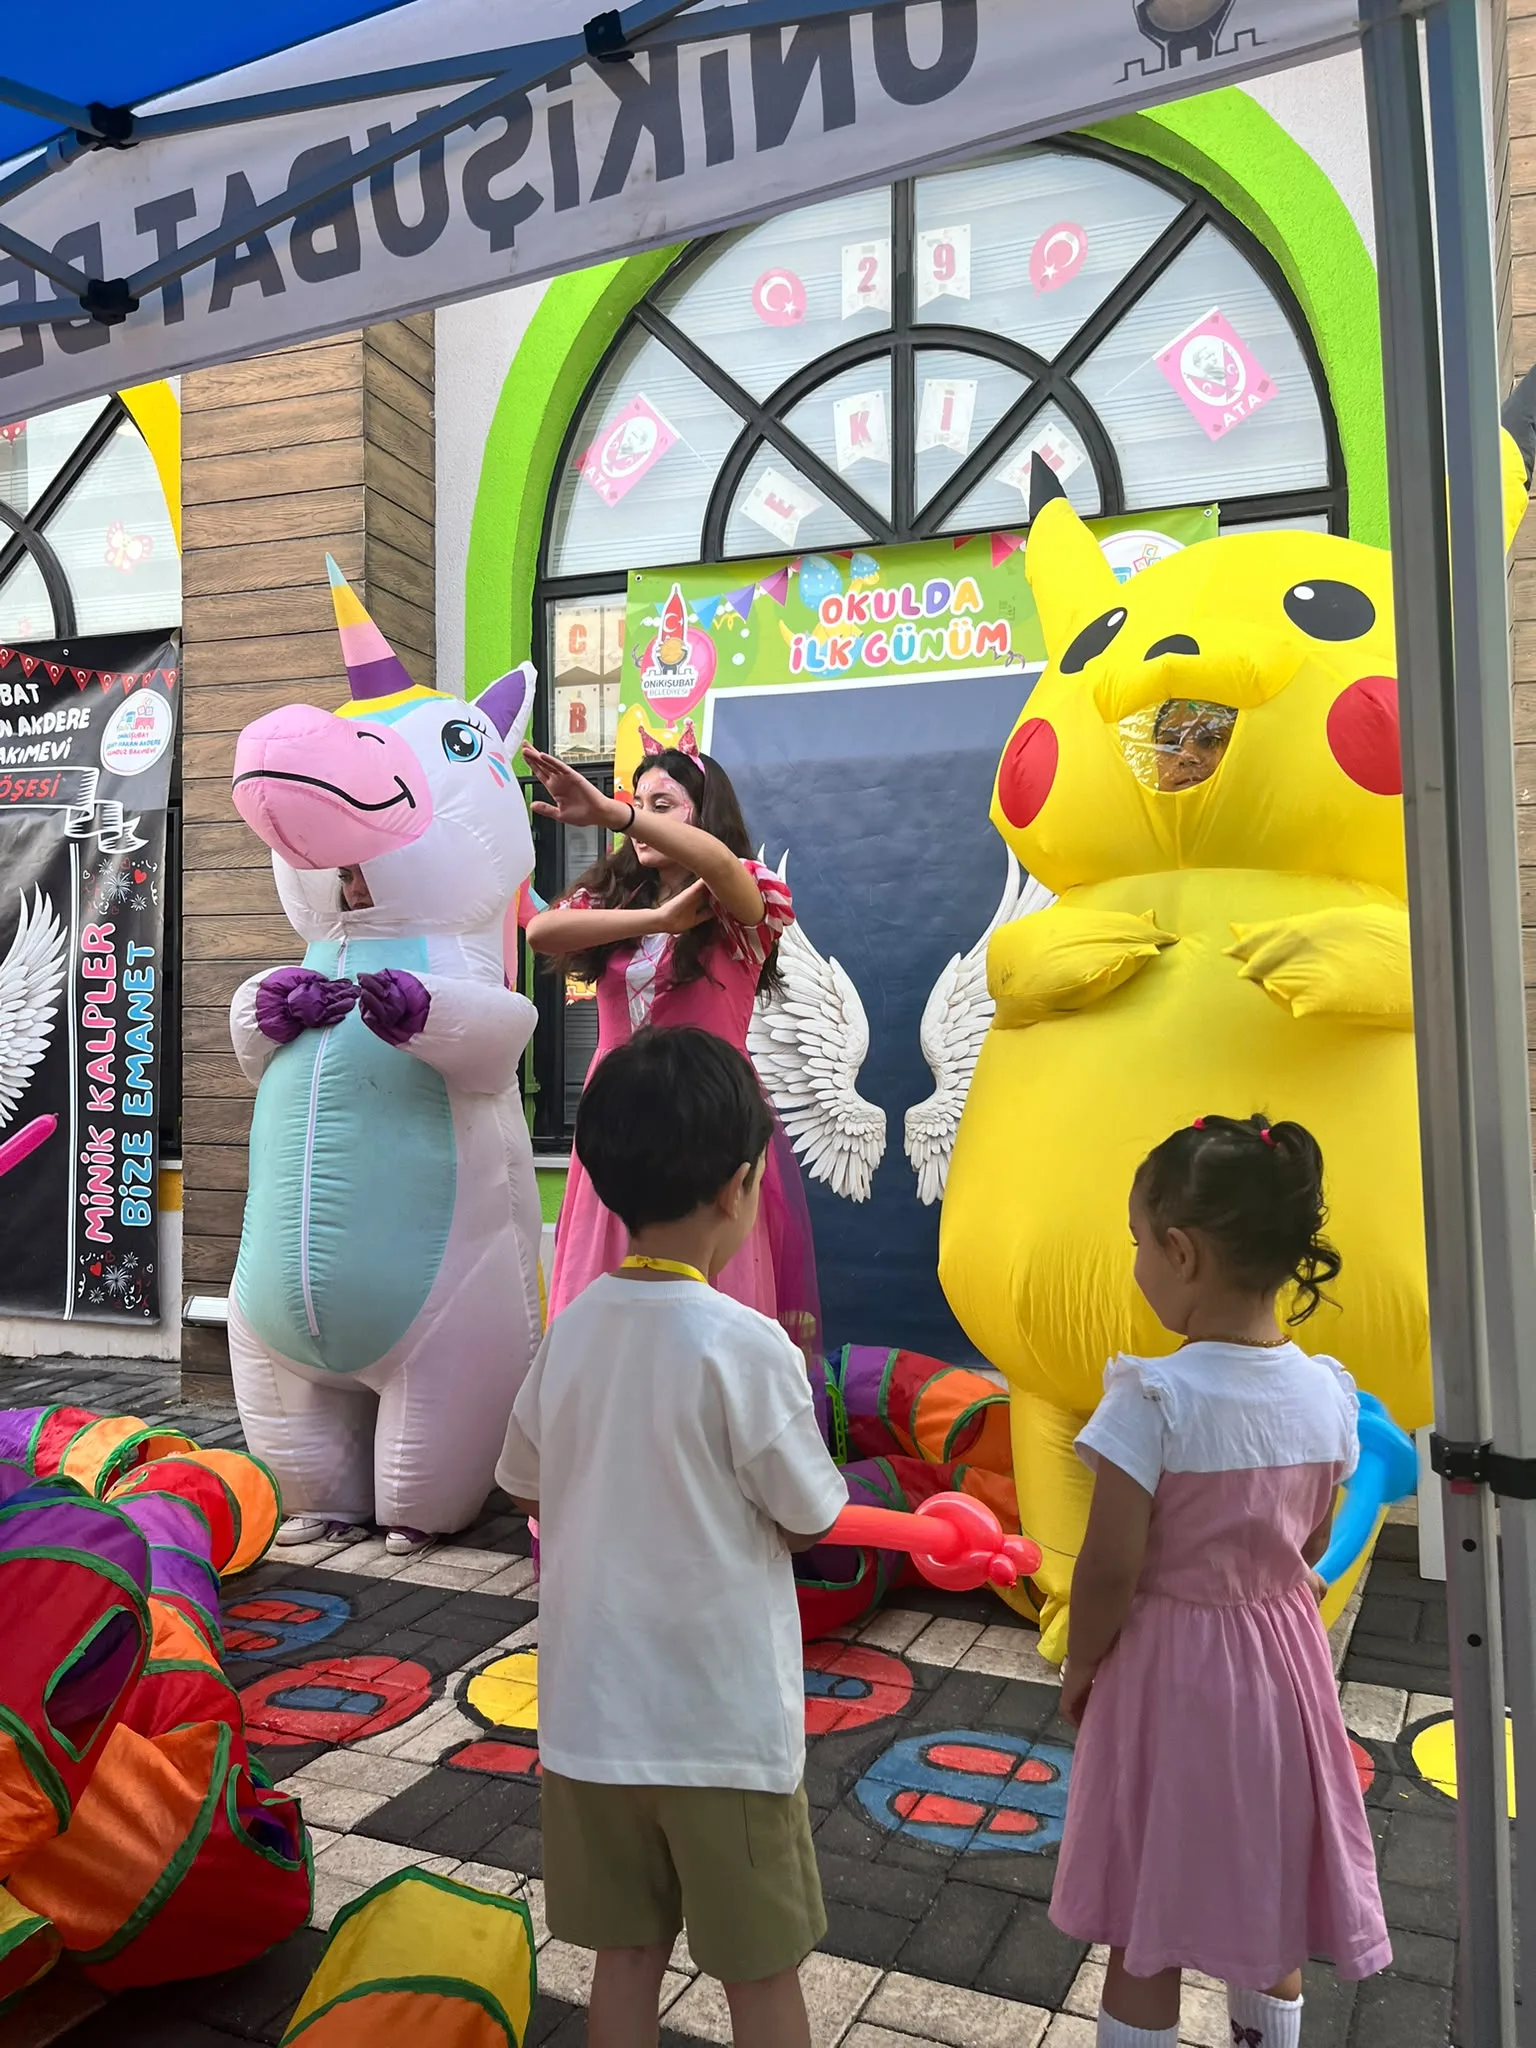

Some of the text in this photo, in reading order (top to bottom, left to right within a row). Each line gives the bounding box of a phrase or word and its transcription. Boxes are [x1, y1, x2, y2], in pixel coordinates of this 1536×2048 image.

[1223, 393, 1262, 428] ATA
[585, 465, 611, 496] ATA
[820, 578, 982, 625] OKULDA
[790, 618, 1009, 671] İLK GÜNÜM
[643, 678, 696, 689] ONİKİŞUBAT
[18, 707, 91, 737] AKDERE
[80, 922, 116, 1243] MİNİK KALPLER
[118, 940, 155, 1227] BİZE EMANET
